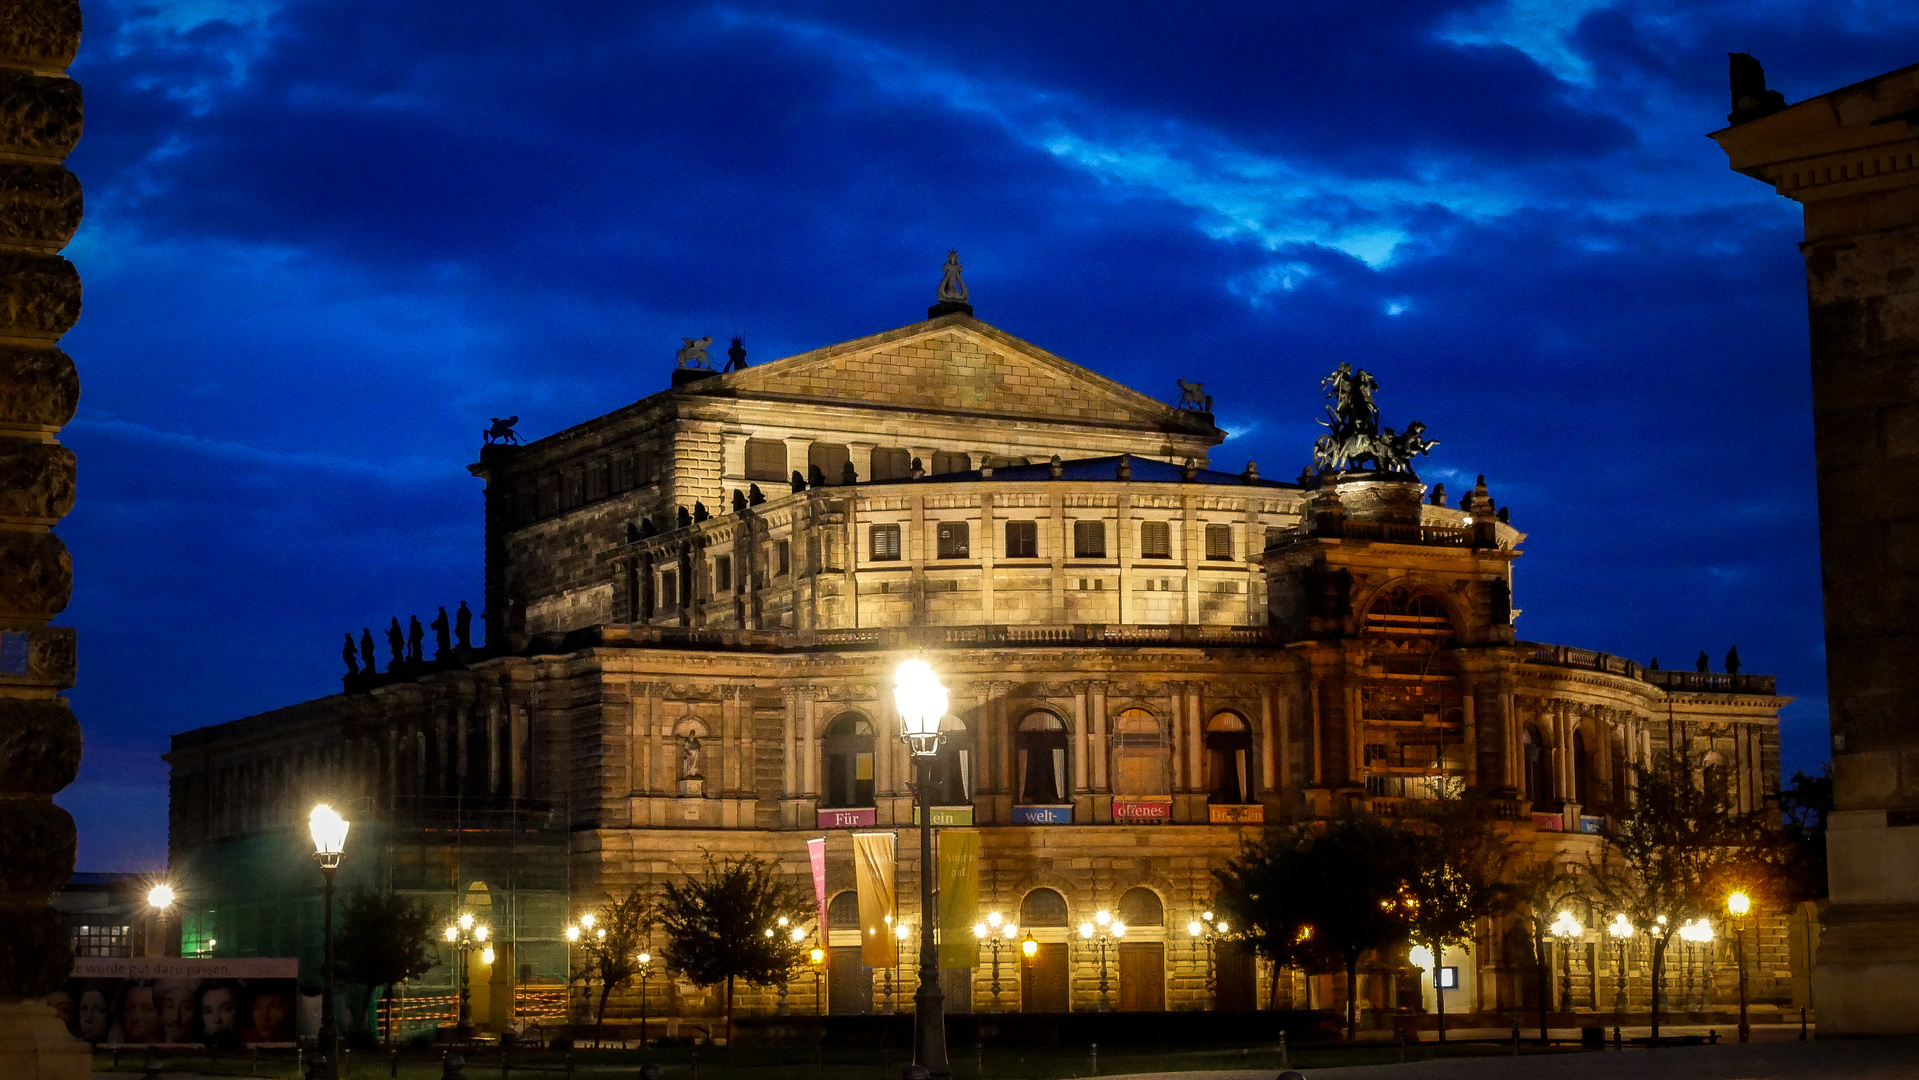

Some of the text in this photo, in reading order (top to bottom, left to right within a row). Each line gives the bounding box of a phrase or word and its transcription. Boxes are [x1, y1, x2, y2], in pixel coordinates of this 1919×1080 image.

[933, 812, 953, 824] ein
[1026, 808, 1057, 822] welt-
[1118, 806, 1164, 818] offenes
[835, 813, 859, 826] Für
[128, 965, 149, 978] gut
[153, 963, 183, 974] dazu
